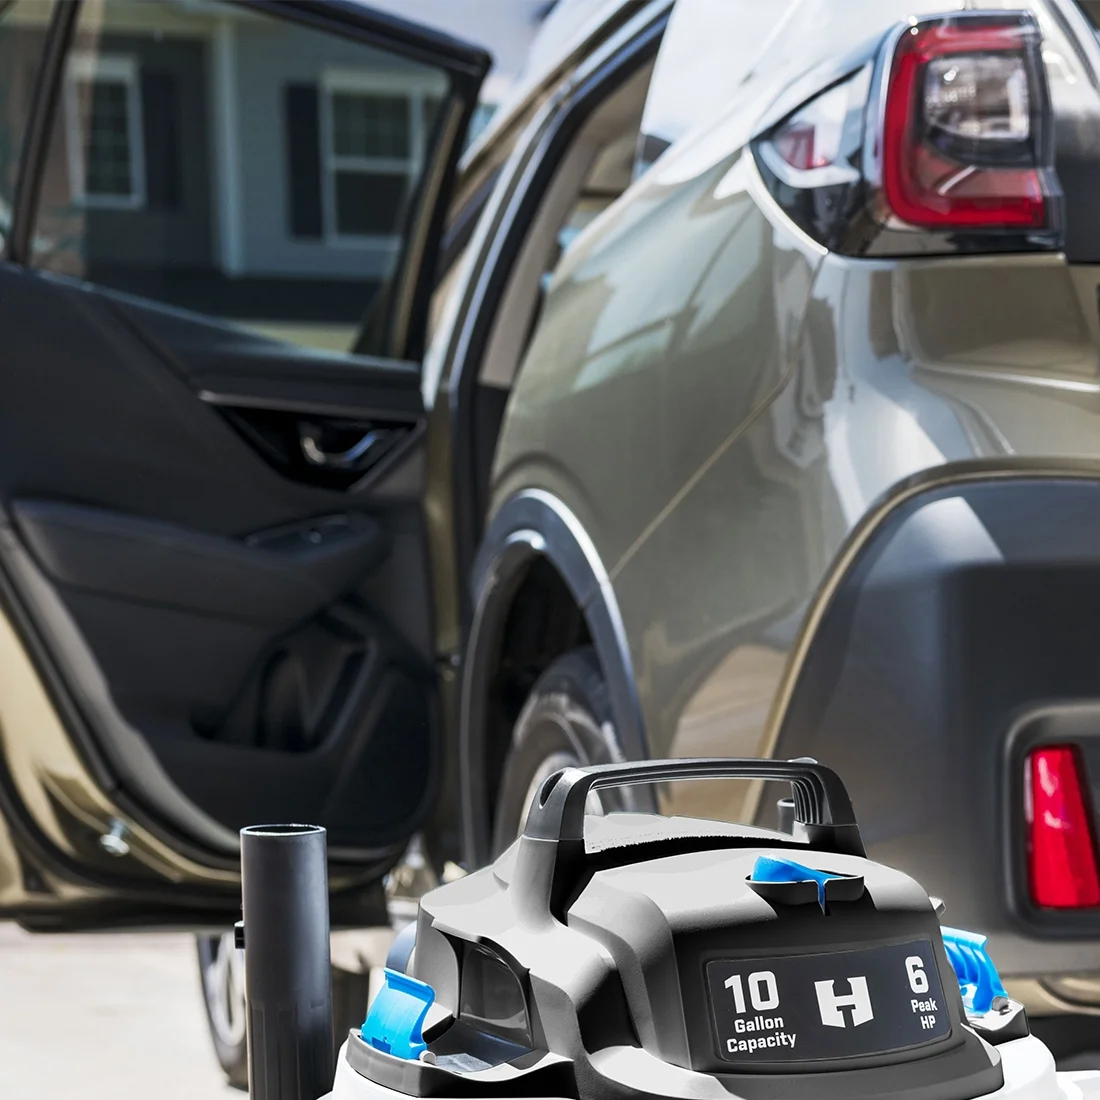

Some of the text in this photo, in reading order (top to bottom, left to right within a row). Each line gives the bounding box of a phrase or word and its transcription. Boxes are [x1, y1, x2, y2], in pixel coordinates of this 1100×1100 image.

[904, 955, 929, 994] 6
[724, 970, 780, 1014] 10
[814, 976, 874, 1028] H
[910, 998, 938, 1013] Peak
[734, 1016, 784, 1034] Gallon
[920, 1014, 936, 1030] HP
[726, 1032, 797, 1053] Capacity
